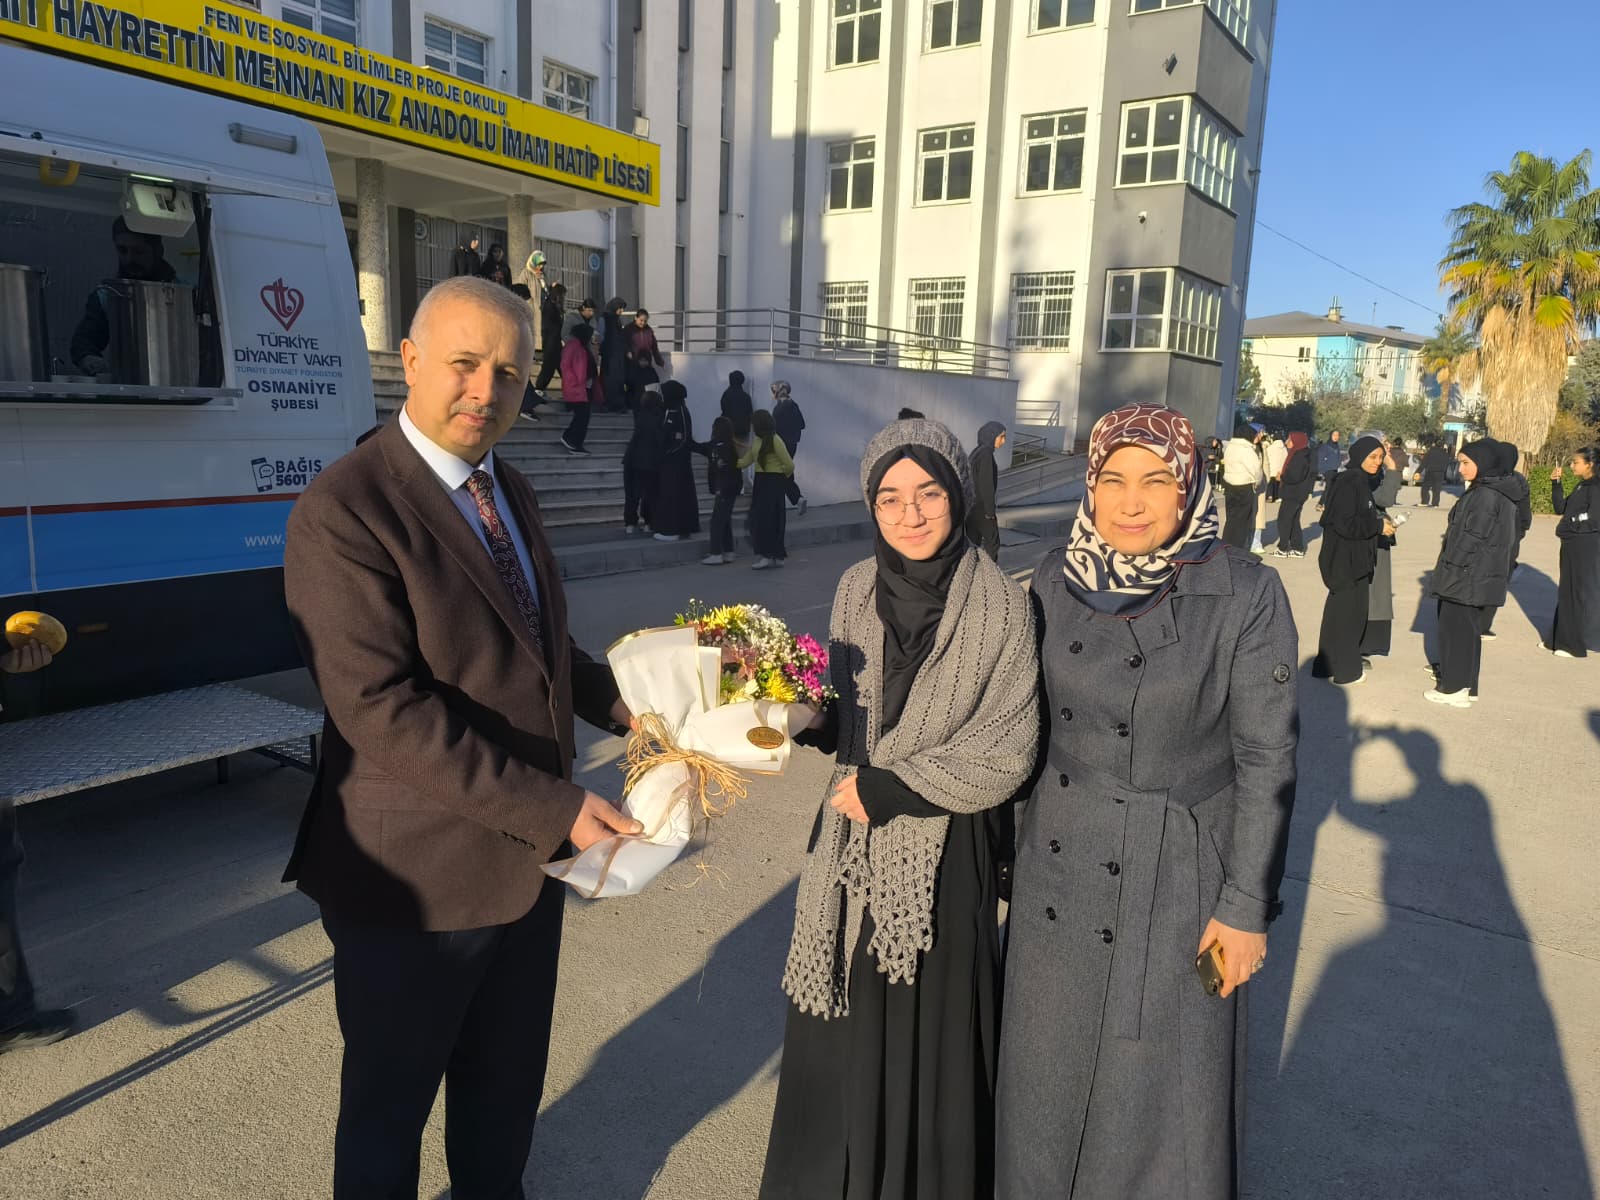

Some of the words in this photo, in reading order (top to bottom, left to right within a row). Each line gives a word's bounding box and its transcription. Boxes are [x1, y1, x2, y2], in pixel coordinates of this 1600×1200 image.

[204, 5, 241, 35] FEN
[244, 18, 269, 43] VE
[272, 27, 339, 66] SOSYAL
[343, 49, 413, 88] BİLİMLER
[416, 74, 460, 103] PROJE
[463, 89, 507, 116] OKULU
[53, 0, 226, 78] HAYRETTİN
[234, 44, 345, 111] MENNAN
[353, 80, 392, 124] KIZ
[400, 96, 497, 151] ANADOLU
[502, 120, 549, 167] İMAM
[554, 144, 600, 180] HATİP
[604, 153, 651, 195] LİSESİ
[257, 332, 320, 351] TÜRKİYE
[234, 347, 298, 365] DİYANET
[303, 353, 342, 368] VAKFI
[247, 379, 337, 396] OSMANİYE
[271, 397, 319, 412] ŞUBESİ
[275, 456, 322, 474] BAĞIŞ
[275, 473, 307, 487] 5601
